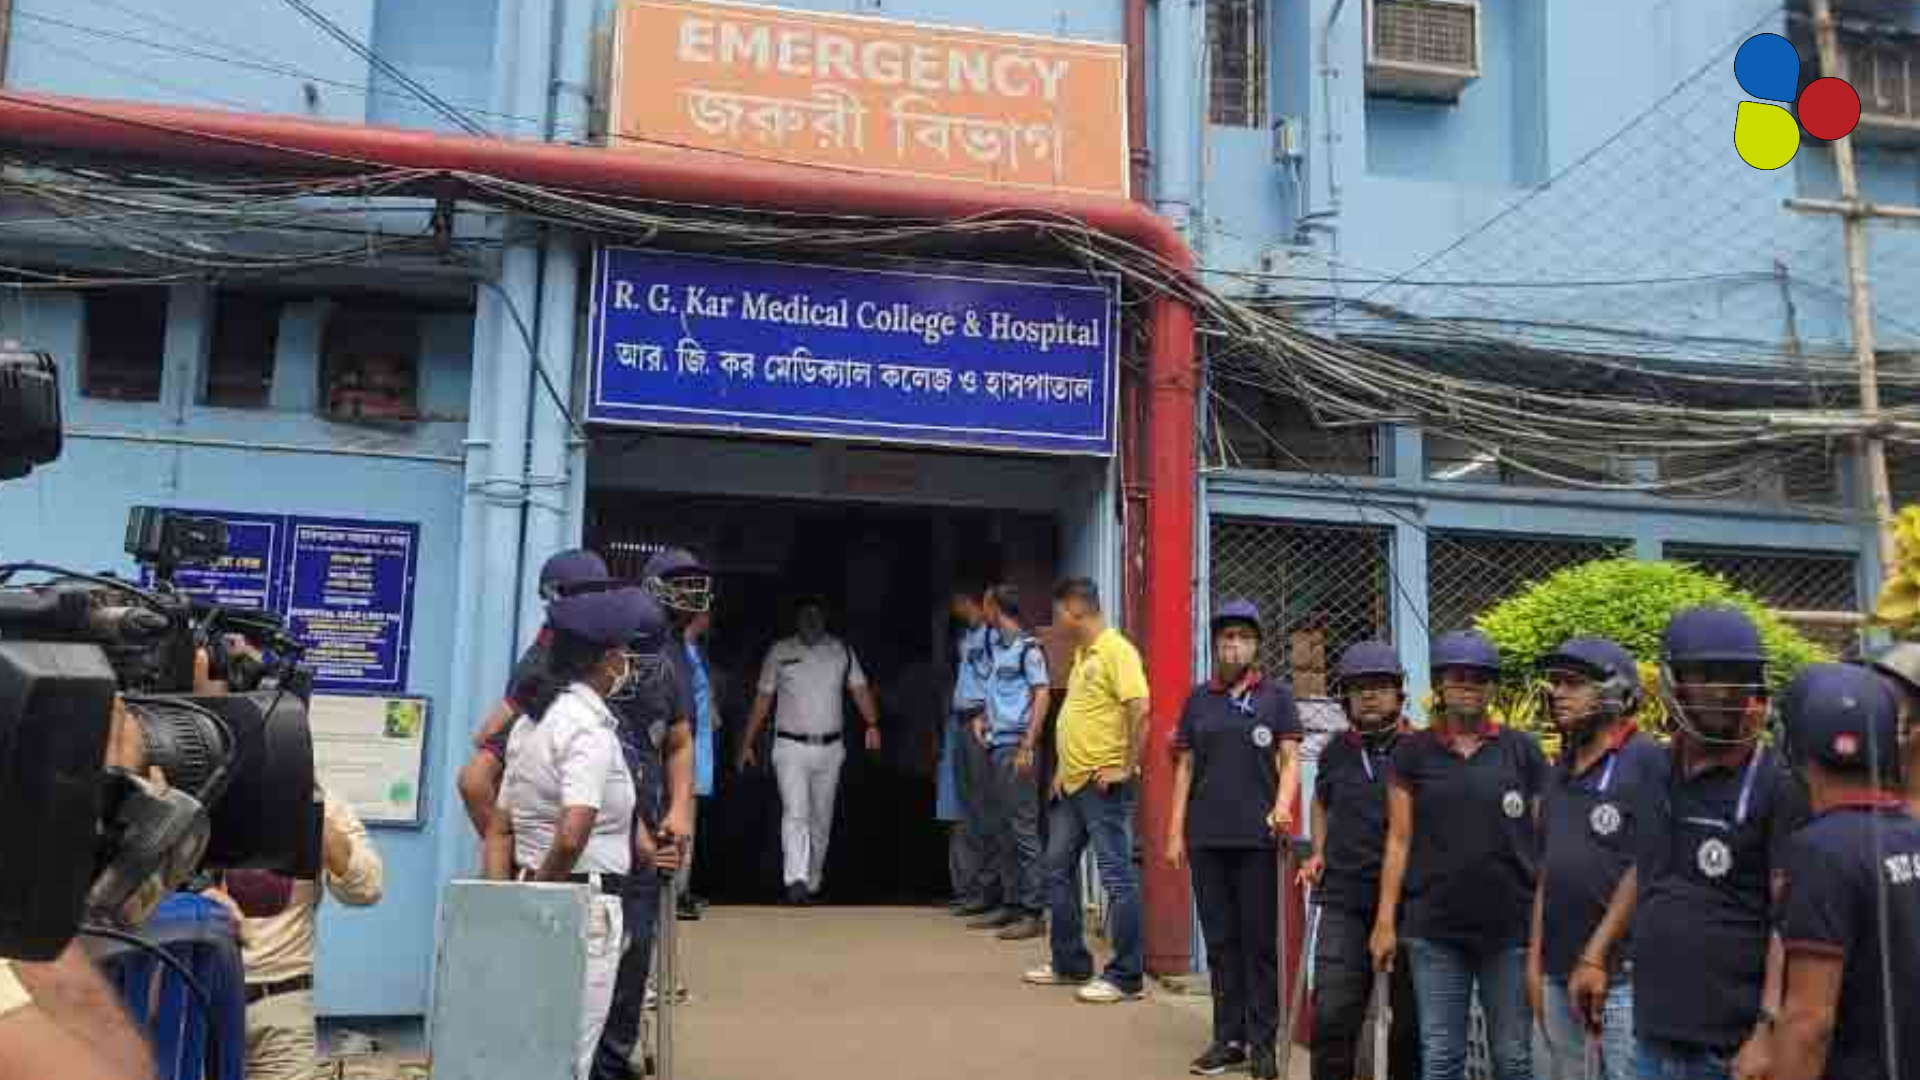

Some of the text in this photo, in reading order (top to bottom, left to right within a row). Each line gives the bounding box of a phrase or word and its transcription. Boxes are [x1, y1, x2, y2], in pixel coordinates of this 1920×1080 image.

[678, 18, 1069, 97] EMERGENCY
[890, 94, 1064, 172] বিভাগ
[613, 280, 1099, 351] R. G. Kar Medical College & Hospital
[719, 351, 755, 380] কর
[763, 346, 872, 388] মেডিক্যাল
[879, 364, 951, 396] কলেজ
[959, 371, 977, 395] ও
[984, 370, 1093, 405] হাসপাতাল
